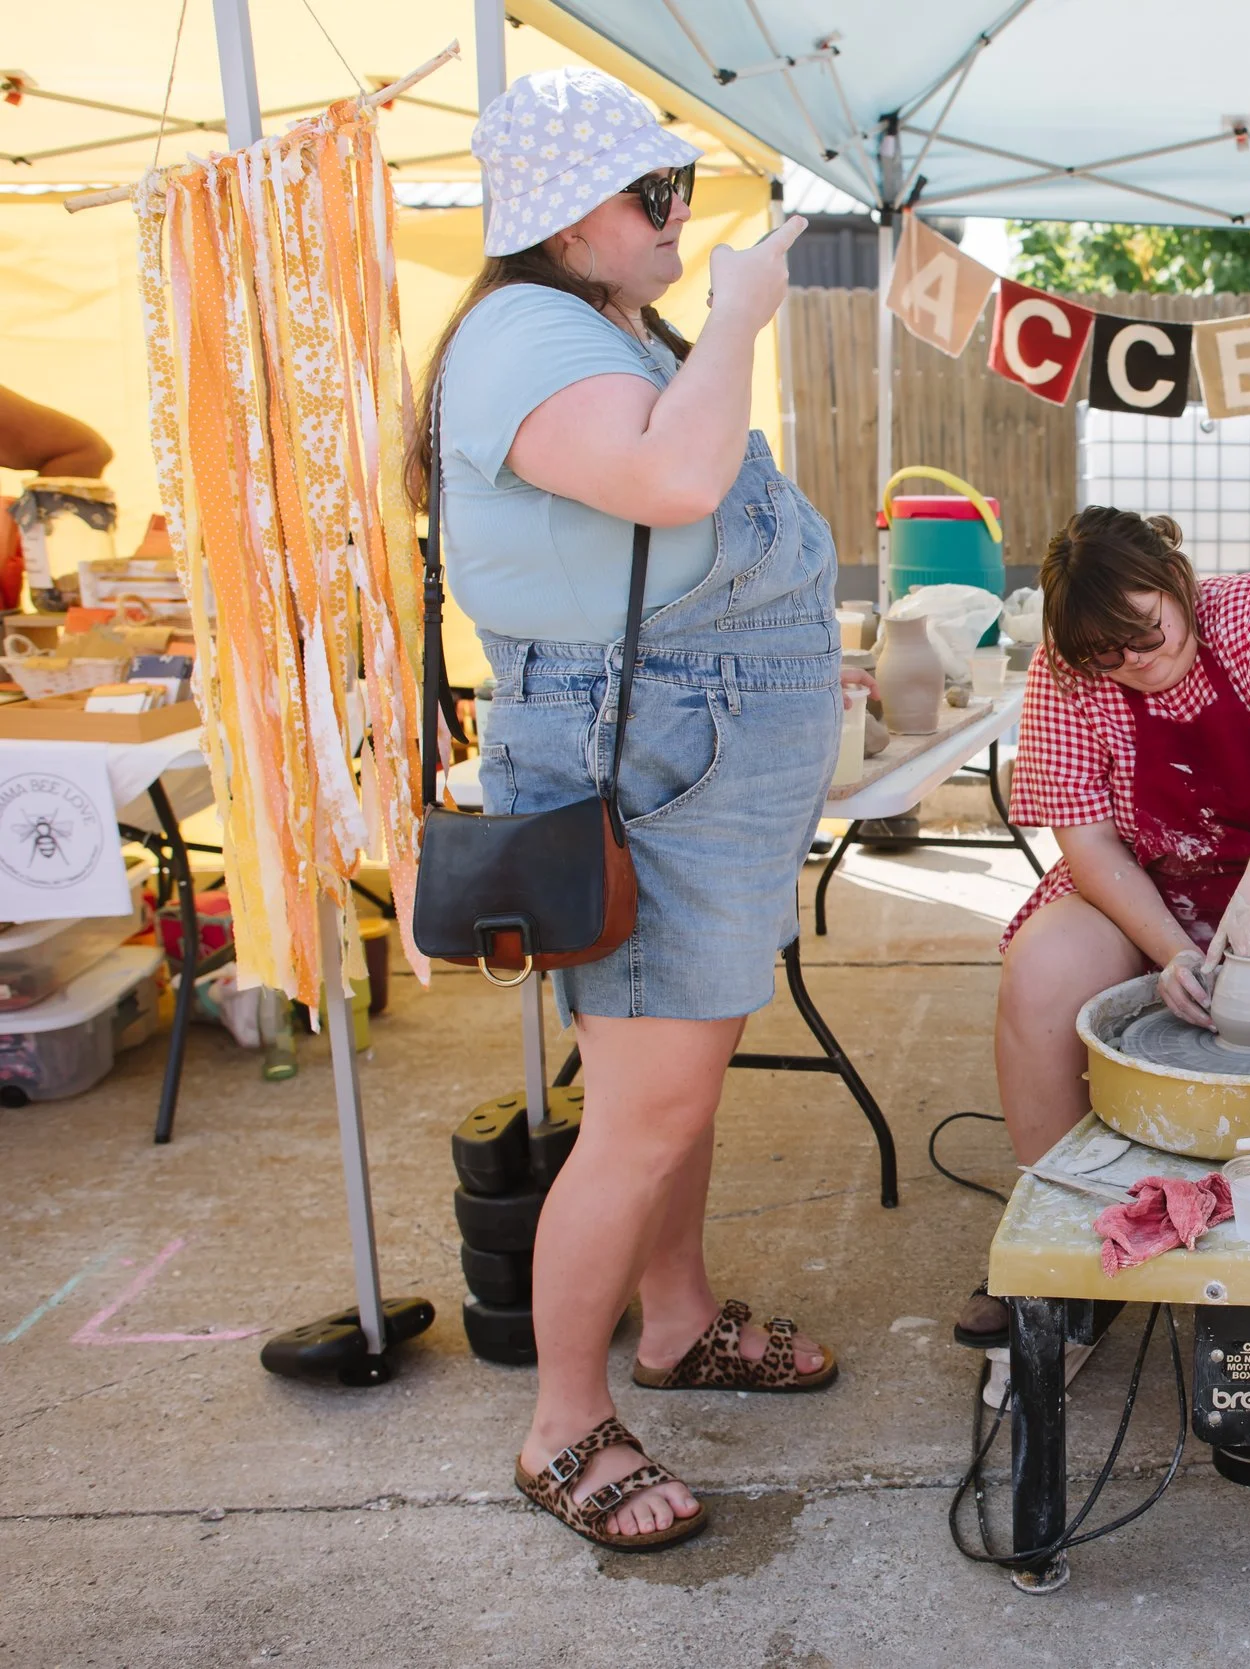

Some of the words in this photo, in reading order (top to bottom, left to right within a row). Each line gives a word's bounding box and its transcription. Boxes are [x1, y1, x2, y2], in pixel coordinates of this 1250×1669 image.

[30, 779, 60, 795] BEE
[62, 787, 96, 827] LOVE
[1226, 1355, 1241, 1363] DO
